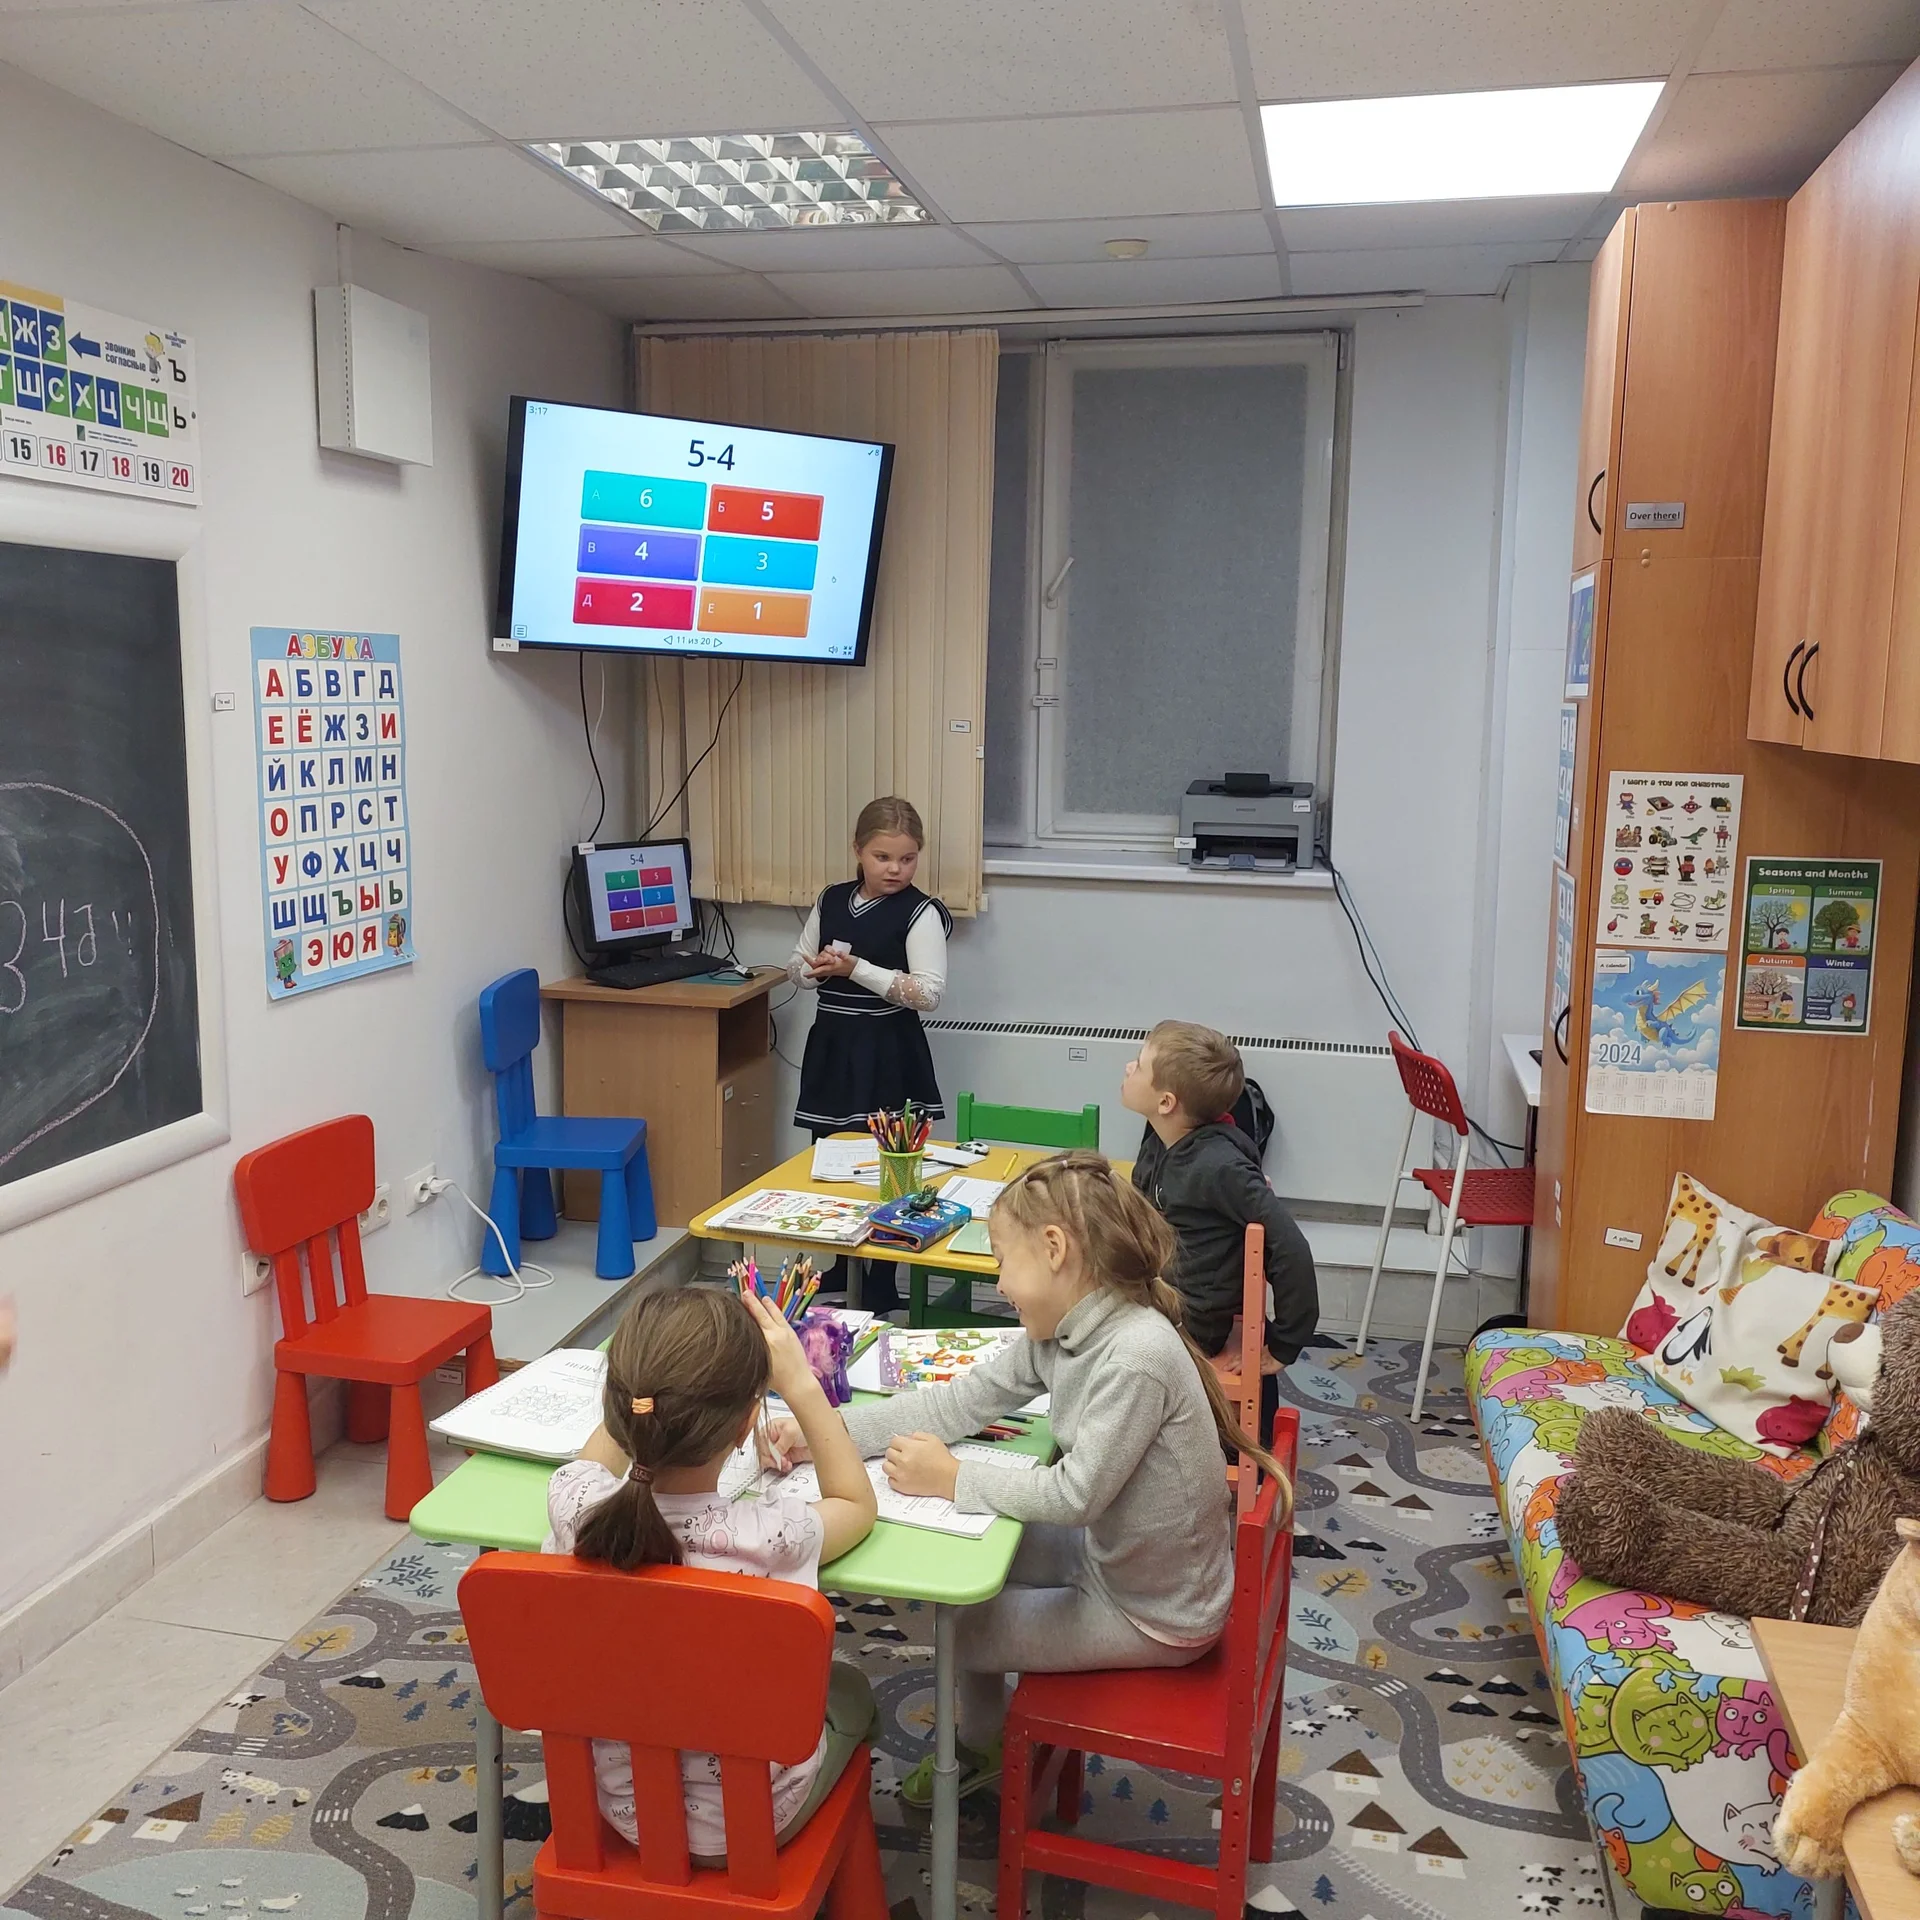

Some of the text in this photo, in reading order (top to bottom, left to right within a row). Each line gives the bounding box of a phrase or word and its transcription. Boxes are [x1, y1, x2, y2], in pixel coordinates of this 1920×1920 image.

[13, 314, 37, 346] Ж
[45, 324, 62, 351] З
[168, 358, 187, 383] Ъ
[16, 368, 41, 399] Ш
[48, 377, 65, 402] С
[75, 382, 92, 410] Х
[100, 388, 118, 420] Ц
[125, 394, 140, 420] Ч
[146, 400, 169, 430] Щ
[173, 407, 187, 429] Ь
[529, 405, 548, 415] 3:17
[10, 436, 189, 487] 15 16 17 18 19 20
[687, 438, 736, 471] 5-4
[640, 488, 653, 508] 6
[717, 501, 775, 521] Б 5
[1629, 510, 1681, 521] Over there!
[588, 541, 649, 561] В 4
[756, 552, 769, 571] 3
[582, 592, 644, 612] Д 2
[707, 601, 763, 620] Е 1
[287, 633, 375, 661] АЗБУКА
[677, 636, 685, 644] 11
[701, 637, 711, 645] 20
[266, 668, 394, 699] А Б В Г Д
[269, 709, 396, 744] Е Ё Ж З И
[268, 755, 396, 791] Й К Л М Н
[270, 796, 397, 837] О П Р С Т
[273, 838, 401, 885] У Ф Х Ц Ч
[630, 853, 644, 865] 5-4
[620, 872, 659, 883] 6 5
[1759, 867, 1869, 879] Seasons and Months
[623, 891, 661, 903] 4 3
[1769, 886, 1796, 896] Spring
[1828, 888, 1863, 897] Summer
[272, 879, 403, 930] Ш Щ Ъ Ы Ь
[625, 915, 631, 923] 2
[307, 925, 377, 967] Э Ю Я
[1759, 956, 1794, 965] Autumn
[1825, 958, 1855, 968] Winter
[1598, 1043, 1641, 1064] 2024
